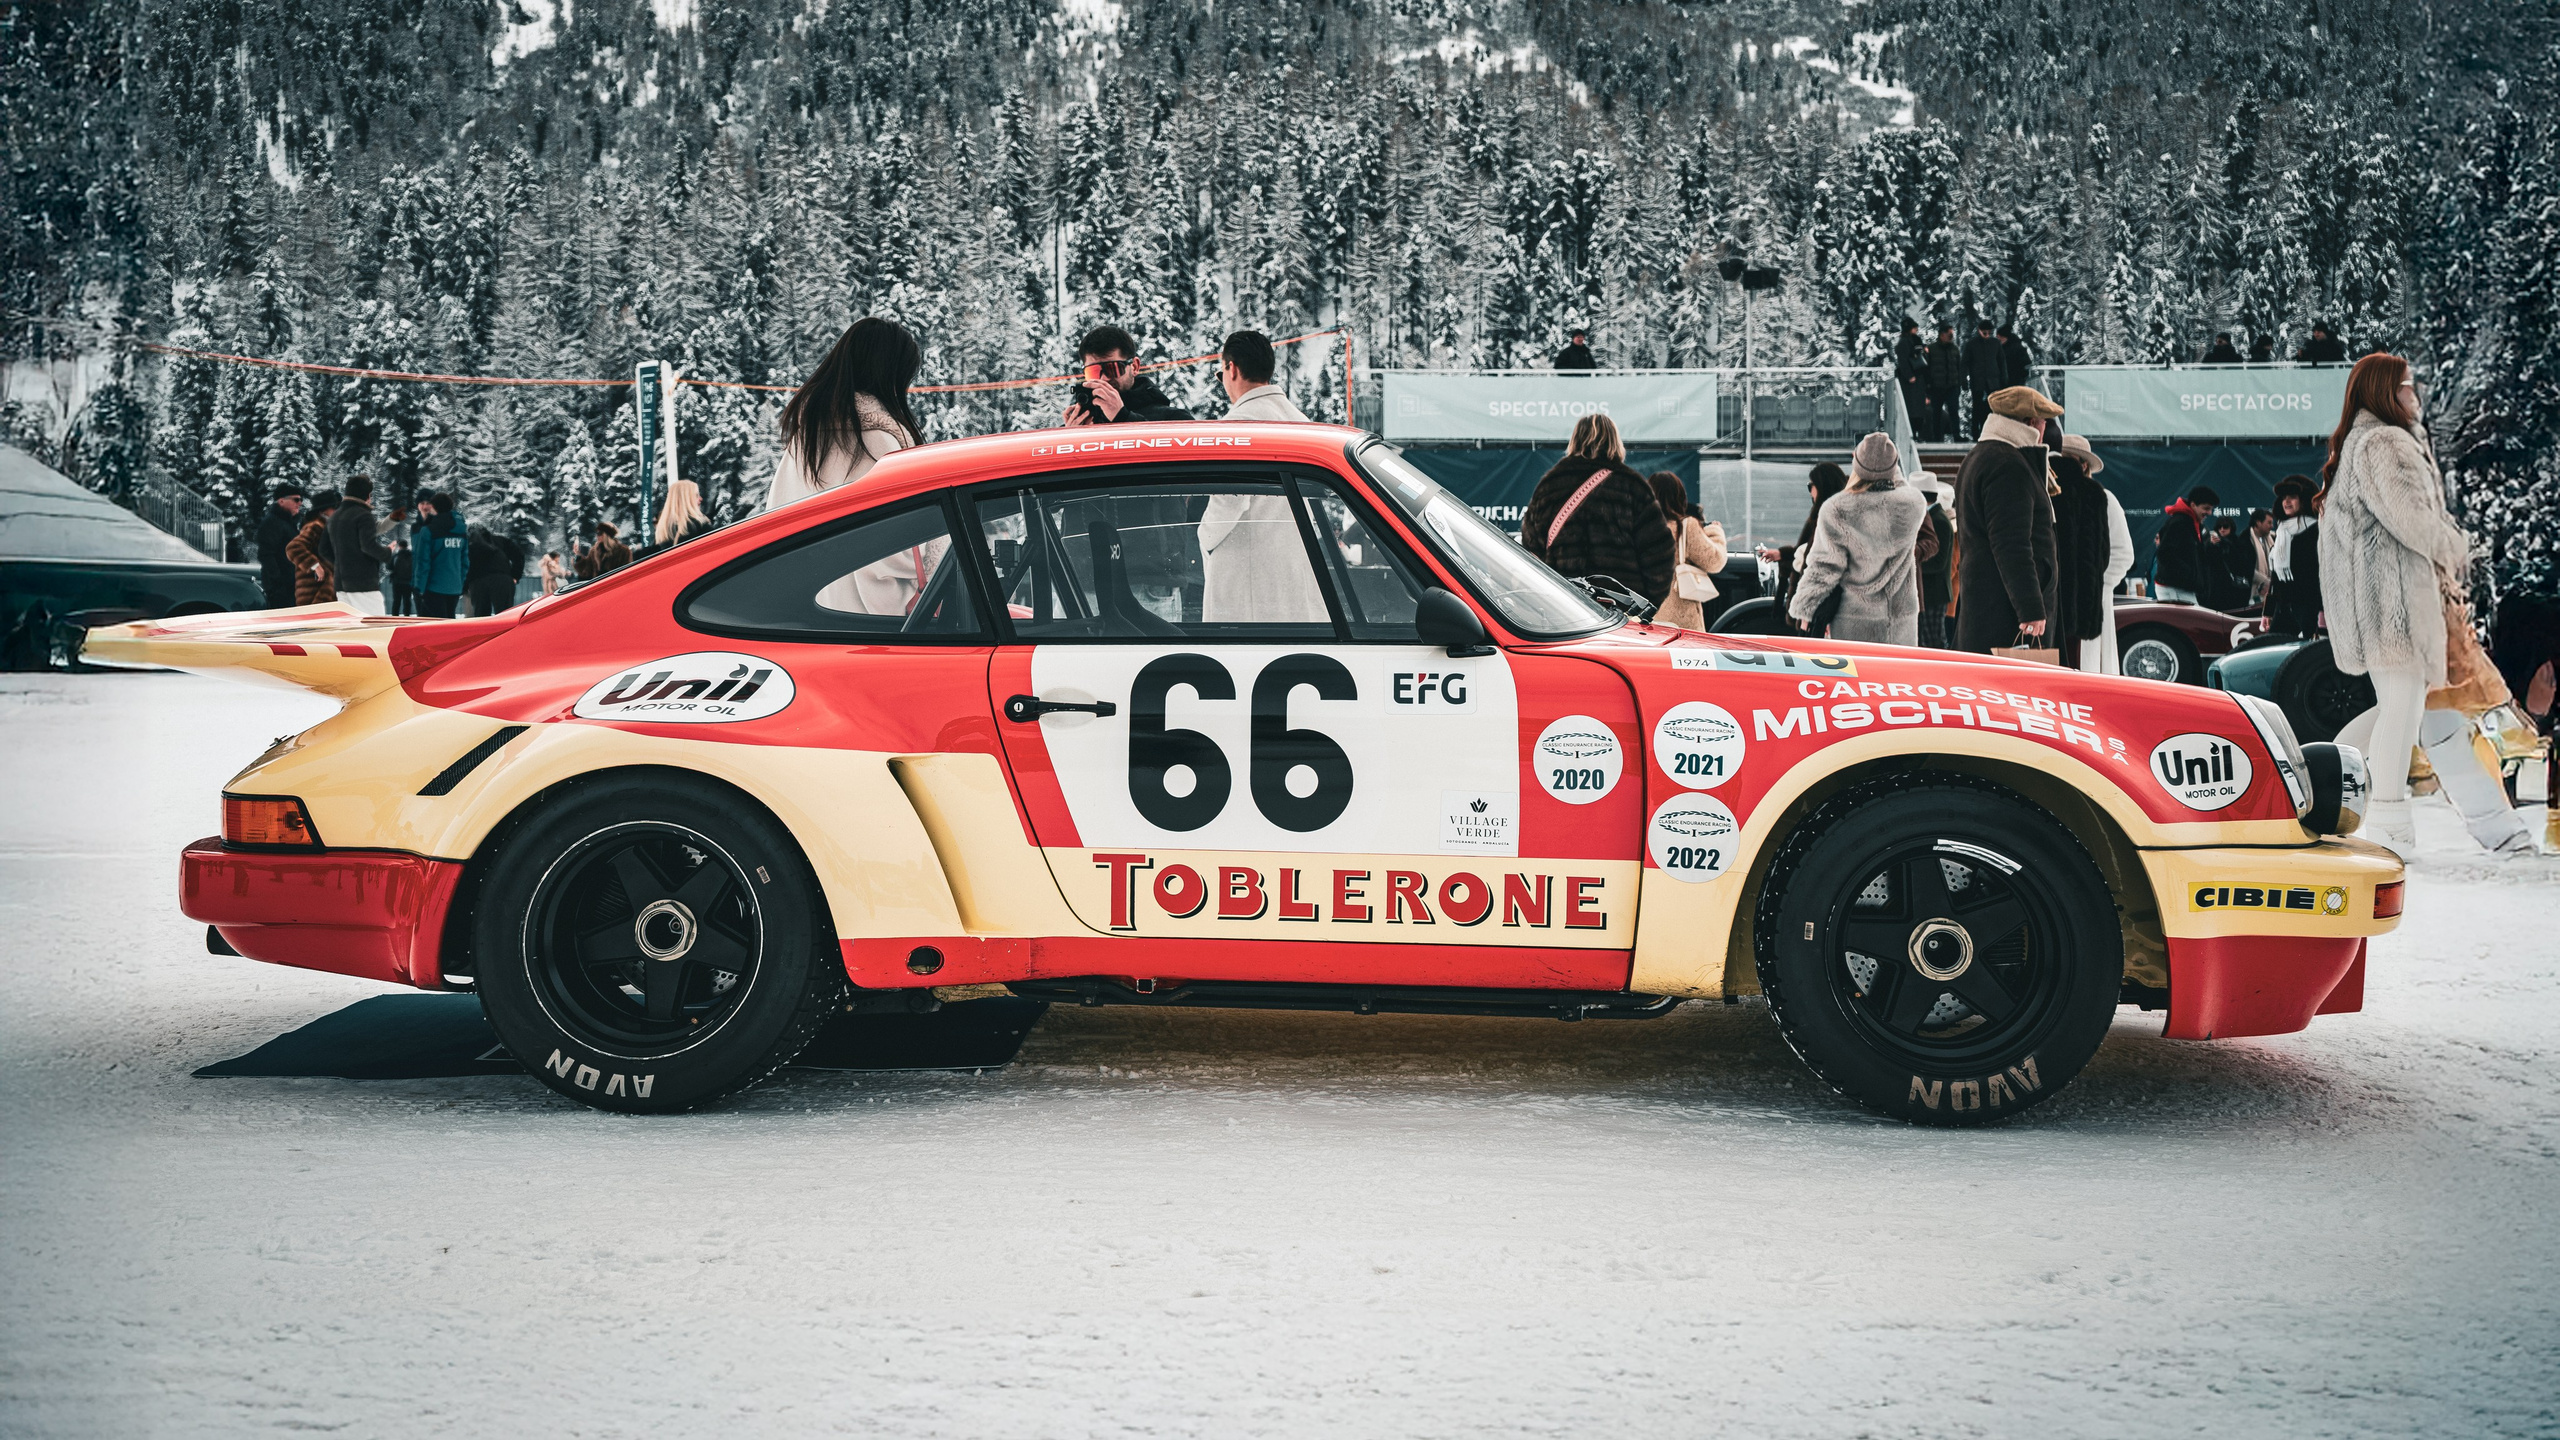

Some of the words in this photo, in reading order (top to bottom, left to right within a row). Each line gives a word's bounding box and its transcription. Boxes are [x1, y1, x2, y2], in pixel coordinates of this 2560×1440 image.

[1488, 400, 1610, 417] SPECTATORS
[2180, 393, 2313, 411] SPECTATORS
[2223, 507, 2241, 517] UBS
[2230, 621, 2254, 649] 6
[1677, 658, 1710, 667] 1974
[598, 663, 773, 706] Unil
[1393, 673, 1467, 705] EFG
[620, 702, 698, 713] MOTOR
[703, 704, 737, 716] OIL
[1797, 680, 2096, 726] CARROSSERIE
[1752, 701, 2105, 755] MISCHLER
[1128, 652, 1358, 833] 66
[1674, 752, 1724, 776] 2021
[2158, 742, 2234, 786] Unil
[1552, 768, 1605, 790] 2020
[2184, 788, 2217, 799] MOTOR
[2219, 786, 2236, 796] OIL
[1449, 815, 1508, 827] VILLAGE
[1456, 827, 1501, 838] VERDE
[1666, 846, 1720, 871] 2022
[1092, 853, 1607, 931] TOBLERONE
[2194, 887, 2316, 911] CIBIÉ
[544, 1048, 655, 1098] AVON
[1908, 1054, 2042, 1111] AVON
